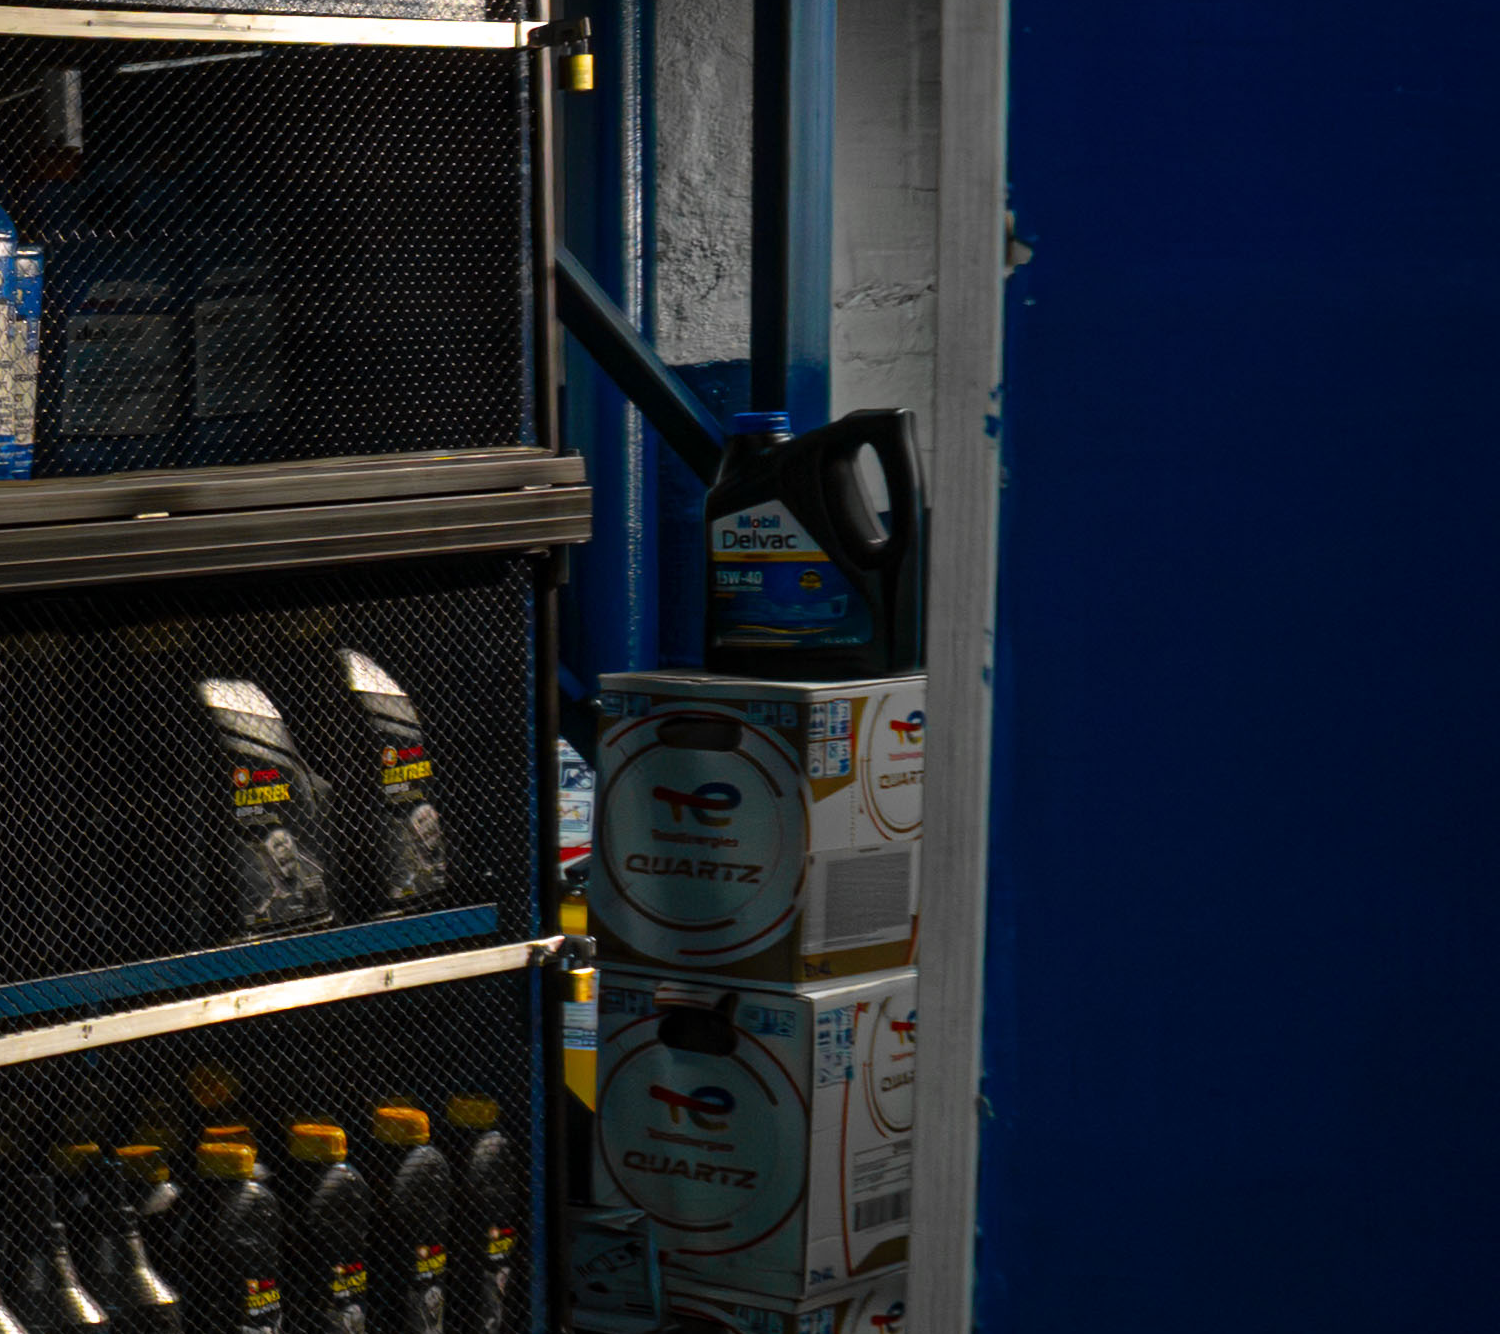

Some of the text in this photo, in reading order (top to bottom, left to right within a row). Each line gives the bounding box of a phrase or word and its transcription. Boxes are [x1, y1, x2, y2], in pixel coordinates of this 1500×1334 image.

[737, 514, 781, 530] Mobil
[721, 529, 798, 550] Delvac
[715, 570, 764, 587] 15W-40
[879, 769, 924, 789] QUART
[624, 853, 764, 884] QUARTZ
[623, 1149, 758, 1190] QUARTZ
